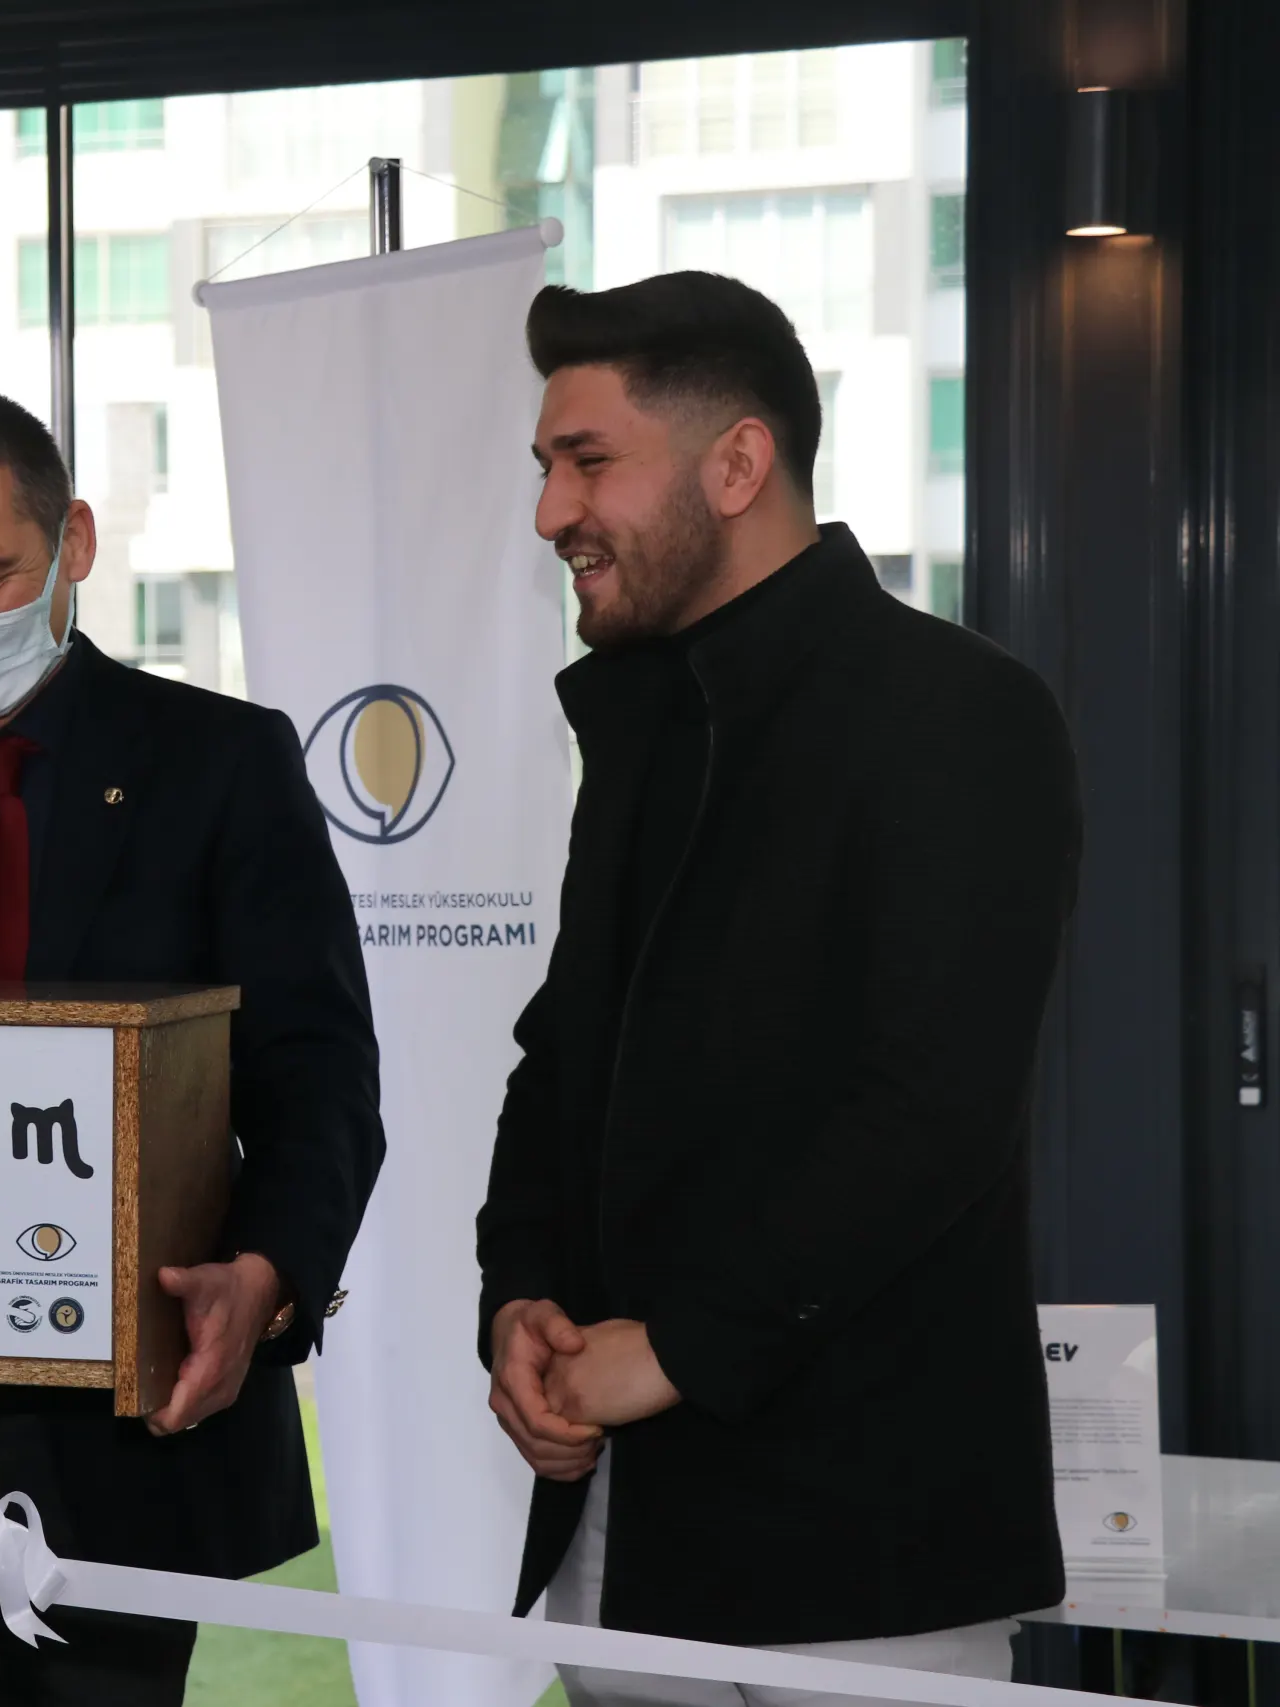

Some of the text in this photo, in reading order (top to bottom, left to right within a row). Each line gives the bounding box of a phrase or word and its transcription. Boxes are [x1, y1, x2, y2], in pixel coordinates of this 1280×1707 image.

[350, 889, 532, 909] TESİ MESLEK YÜKSEKOKULU
[357, 922, 535, 947] ARIM PROGRAMI
[1045, 1342, 1079, 1362] EV
